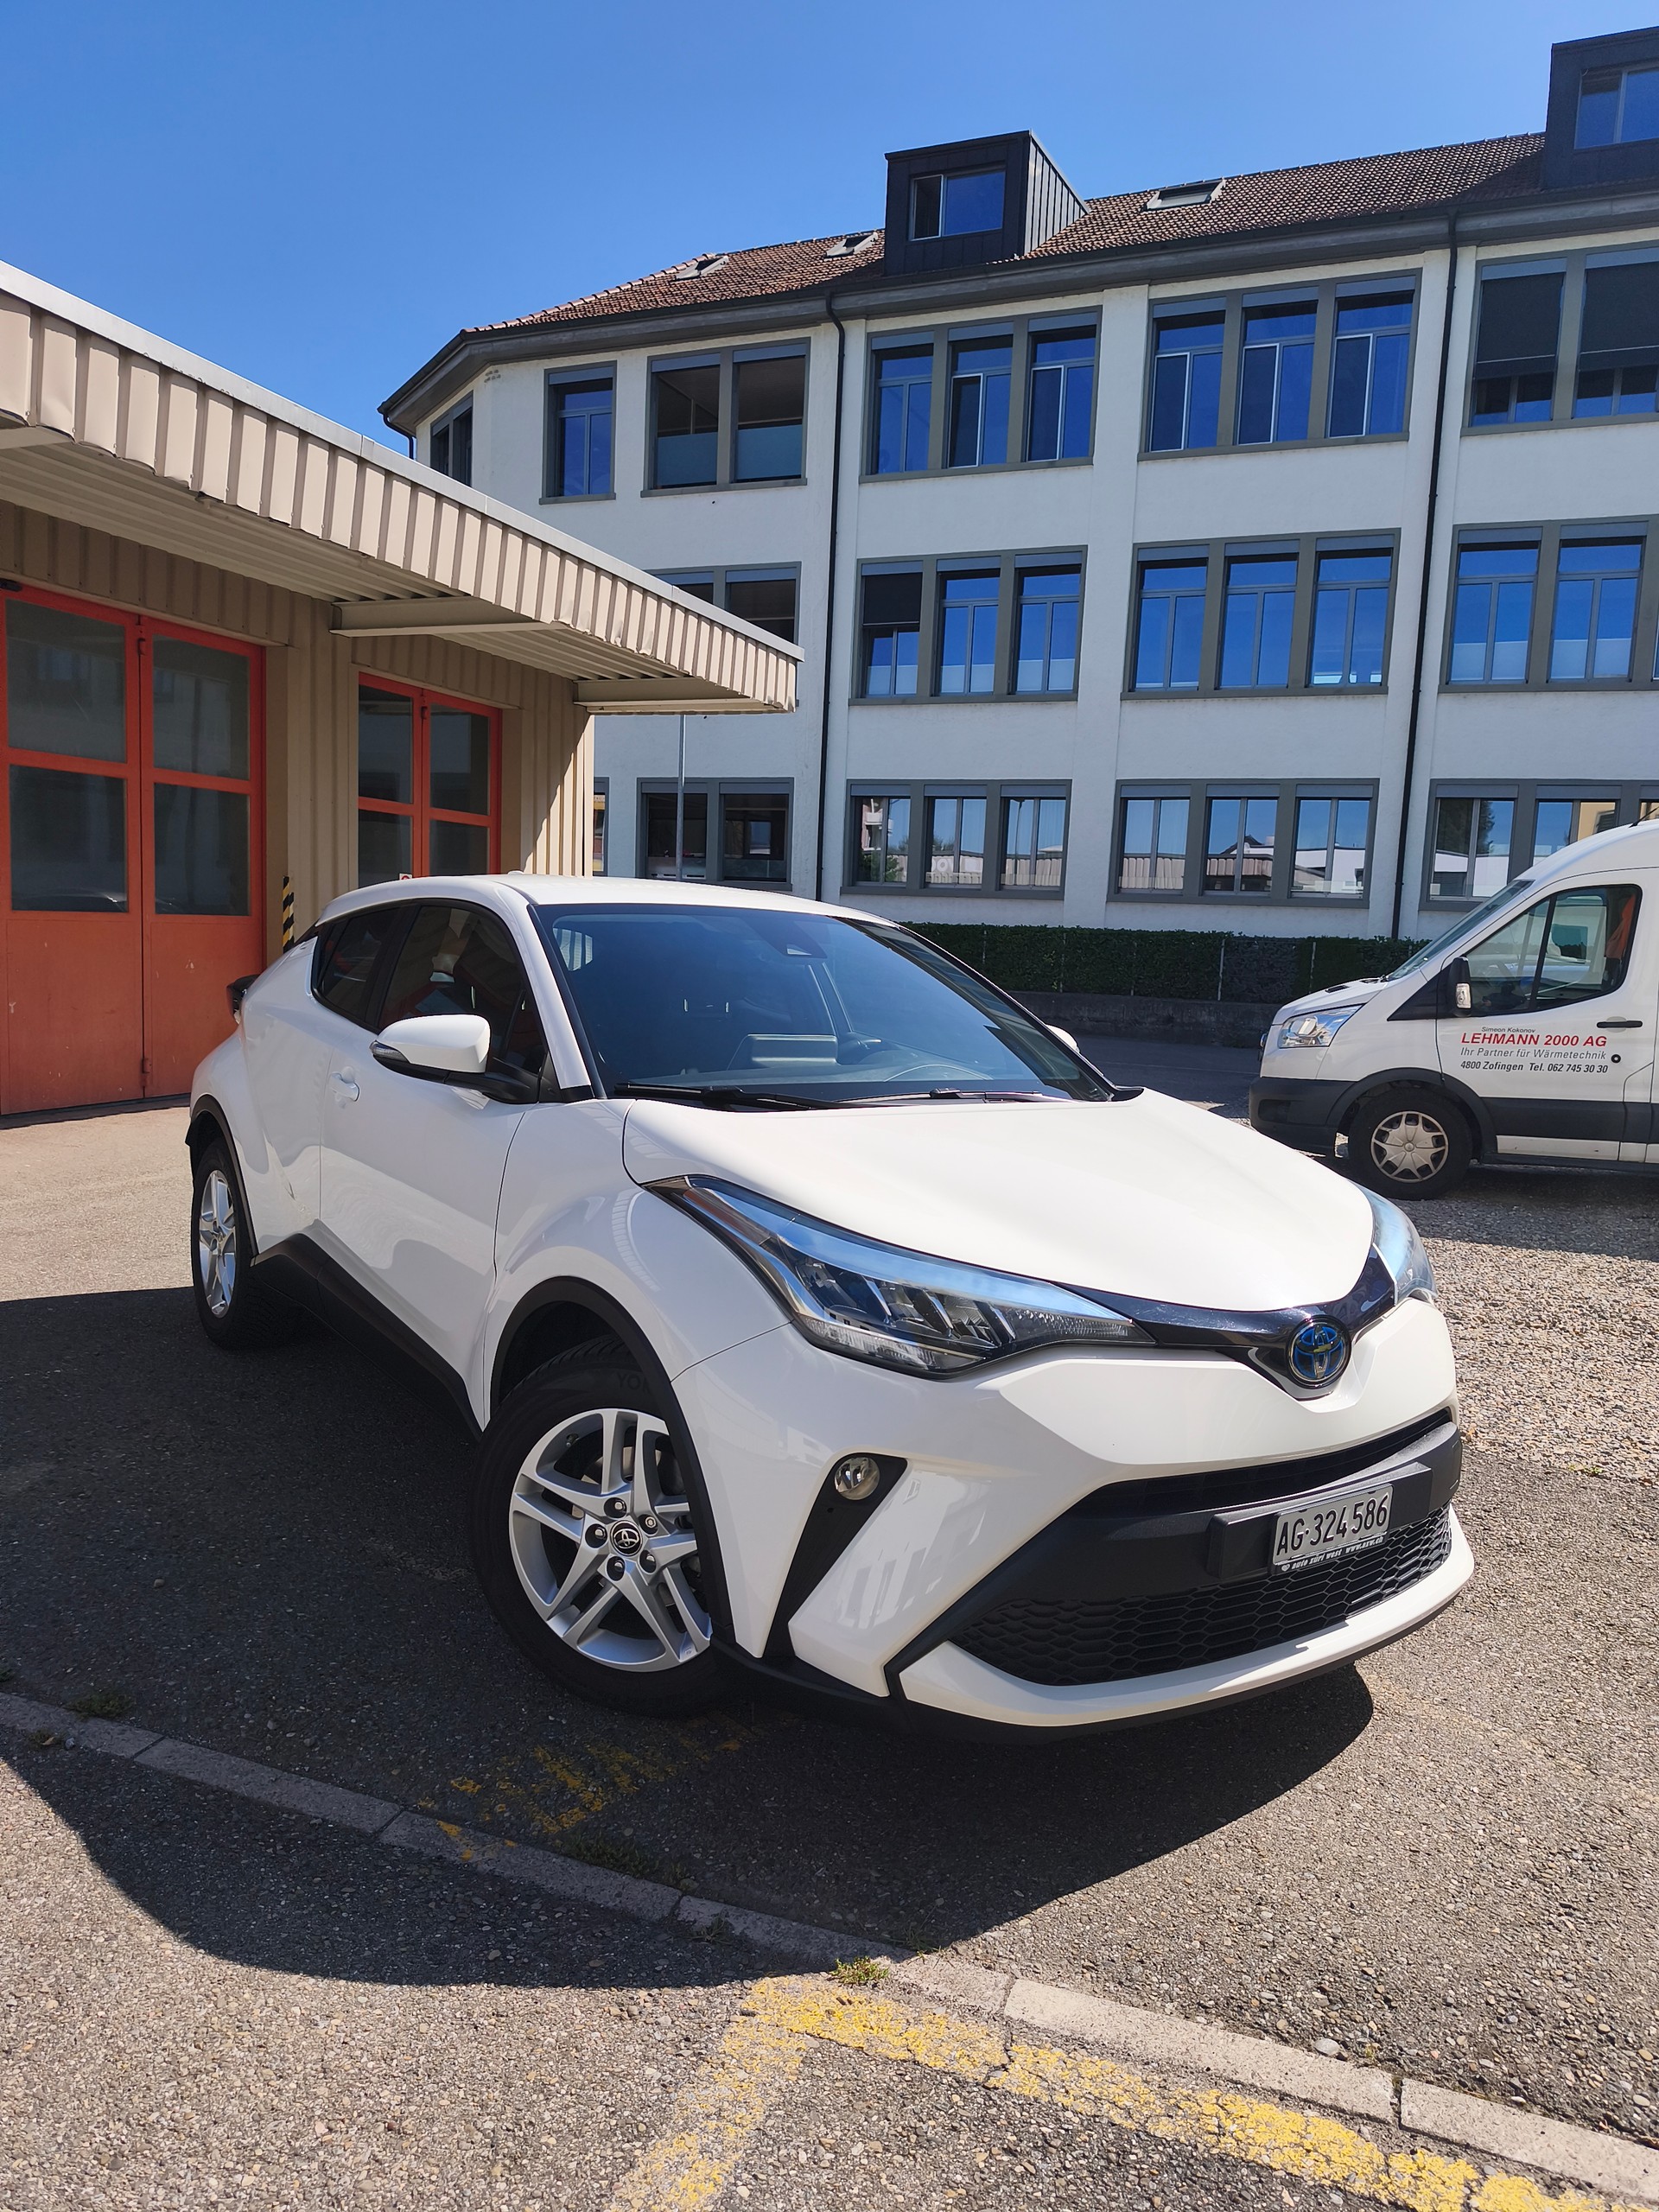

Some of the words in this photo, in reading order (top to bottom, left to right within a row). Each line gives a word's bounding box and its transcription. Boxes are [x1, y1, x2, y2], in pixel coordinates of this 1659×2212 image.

[1461, 1033, 1540, 1046] LEHMANN
[1544, 1035, 1578, 1046] 2000
[1583, 1036, 1607, 1046] AG
[1460, 1047, 1475, 1056] Ihr
[1478, 1048, 1514, 1058] Partner
[1516, 1048, 1531, 1058] für
[1534, 1049, 1606, 1059] Wärmetechnik
[1483, 1061, 1523, 1072] Zofingen
[1529, 1063, 1544, 1071] Tel.
[1548, 1064, 1563, 1072] 062
[1567, 1064, 1582, 1072] 745
[1584, 1065, 1595, 1073] 30
